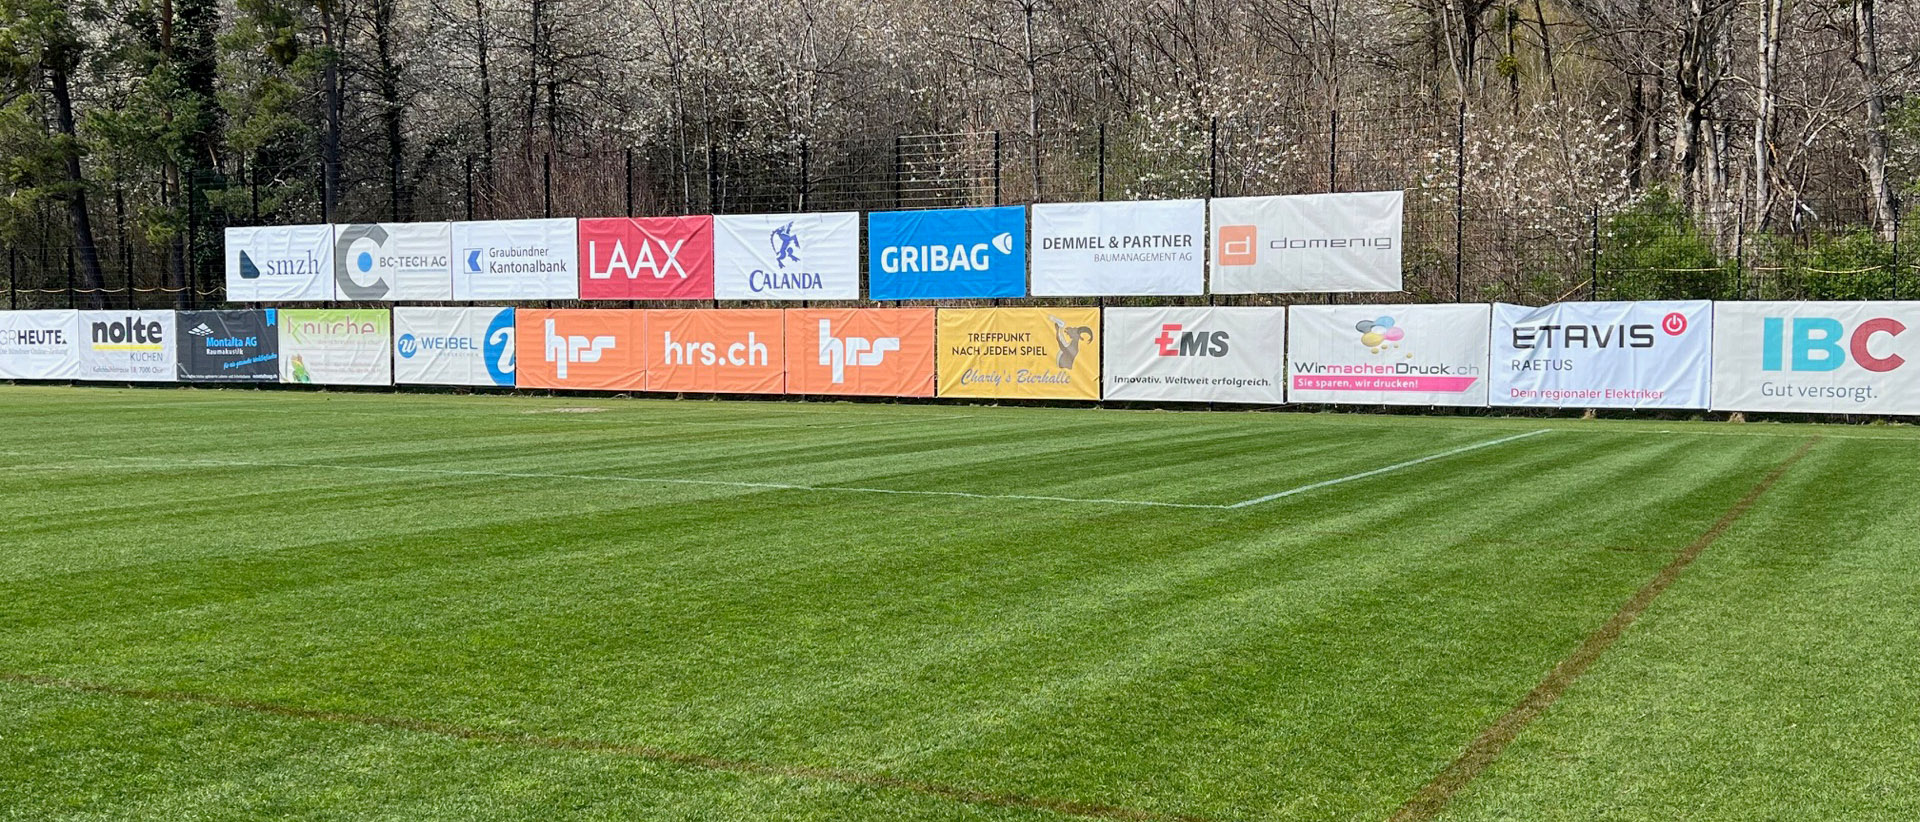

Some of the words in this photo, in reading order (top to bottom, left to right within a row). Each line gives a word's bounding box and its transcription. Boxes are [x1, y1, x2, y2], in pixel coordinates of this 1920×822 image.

[1043, 236, 1105, 250] DEMMEL
[1108, 236, 1119, 249] &
[1122, 234, 1192, 248] PARTNER
[1270, 235, 1392, 250] domenig
[489, 246, 549, 258] Graubündner
[589, 238, 688, 280] LAAX
[880, 243, 989, 273] GRIBAG
[1094, 252, 1177, 263] BAUMANAGEMENT
[1178, 252, 1193, 262] AG
[266, 250, 319, 276] smzh
[379, 256, 428, 268] BC-TECH
[430, 255, 447, 267] AG
[489, 259, 567, 274] Kantonalbank
[92, 316, 163, 344] nolte
[968, 332, 1031, 342] TREFFPUNKT
[1512, 324, 1655, 349] ETAVIS
[206, 336, 243, 347] Montalta
[244, 336, 257, 347] AG
[421, 337, 478, 350] WEIBEL
[1155, 323, 1229, 357] EMS
[1762, 316, 1907, 373] IBC
[545, 318, 616, 379] hrs
[664, 331, 768, 366] hrs.ch
[819, 318, 900, 384] hrs
[952, 346, 980, 355] NACH
[983, 346, 1017, 355] JEDEM
[1020, 346, 1047, 355] SPIEL
[1294, 362, 1480, 375] WirmachenDruck.ch
[1511, 359, 1573, 371] RAETUS
[960, 368, 1011, 386] Charly's
[1016, 369, 1072, 384] Bierhalle
[1113, 375, 1162, 384] Innovativ.
[1165, 376, 1208, 385] Weltweit
[1211, 377, 1272, 388] erfolgreich.
[1297, 378, 1313, 387] Sie
[1315, 379, 1352, 389] sparen,
[1355, 379, 1371, 388] wir
[1373, 379, 1419, 388] drucken!
[1510, 388, 1537, 398] Dein
[1540, 388, 1601, 401] regionaler
[1604, 388, 1665, 399] Elektriker
[1761, 381, 1793, 398] Gut
[1797, 383, 1878, 403] versorgt.
